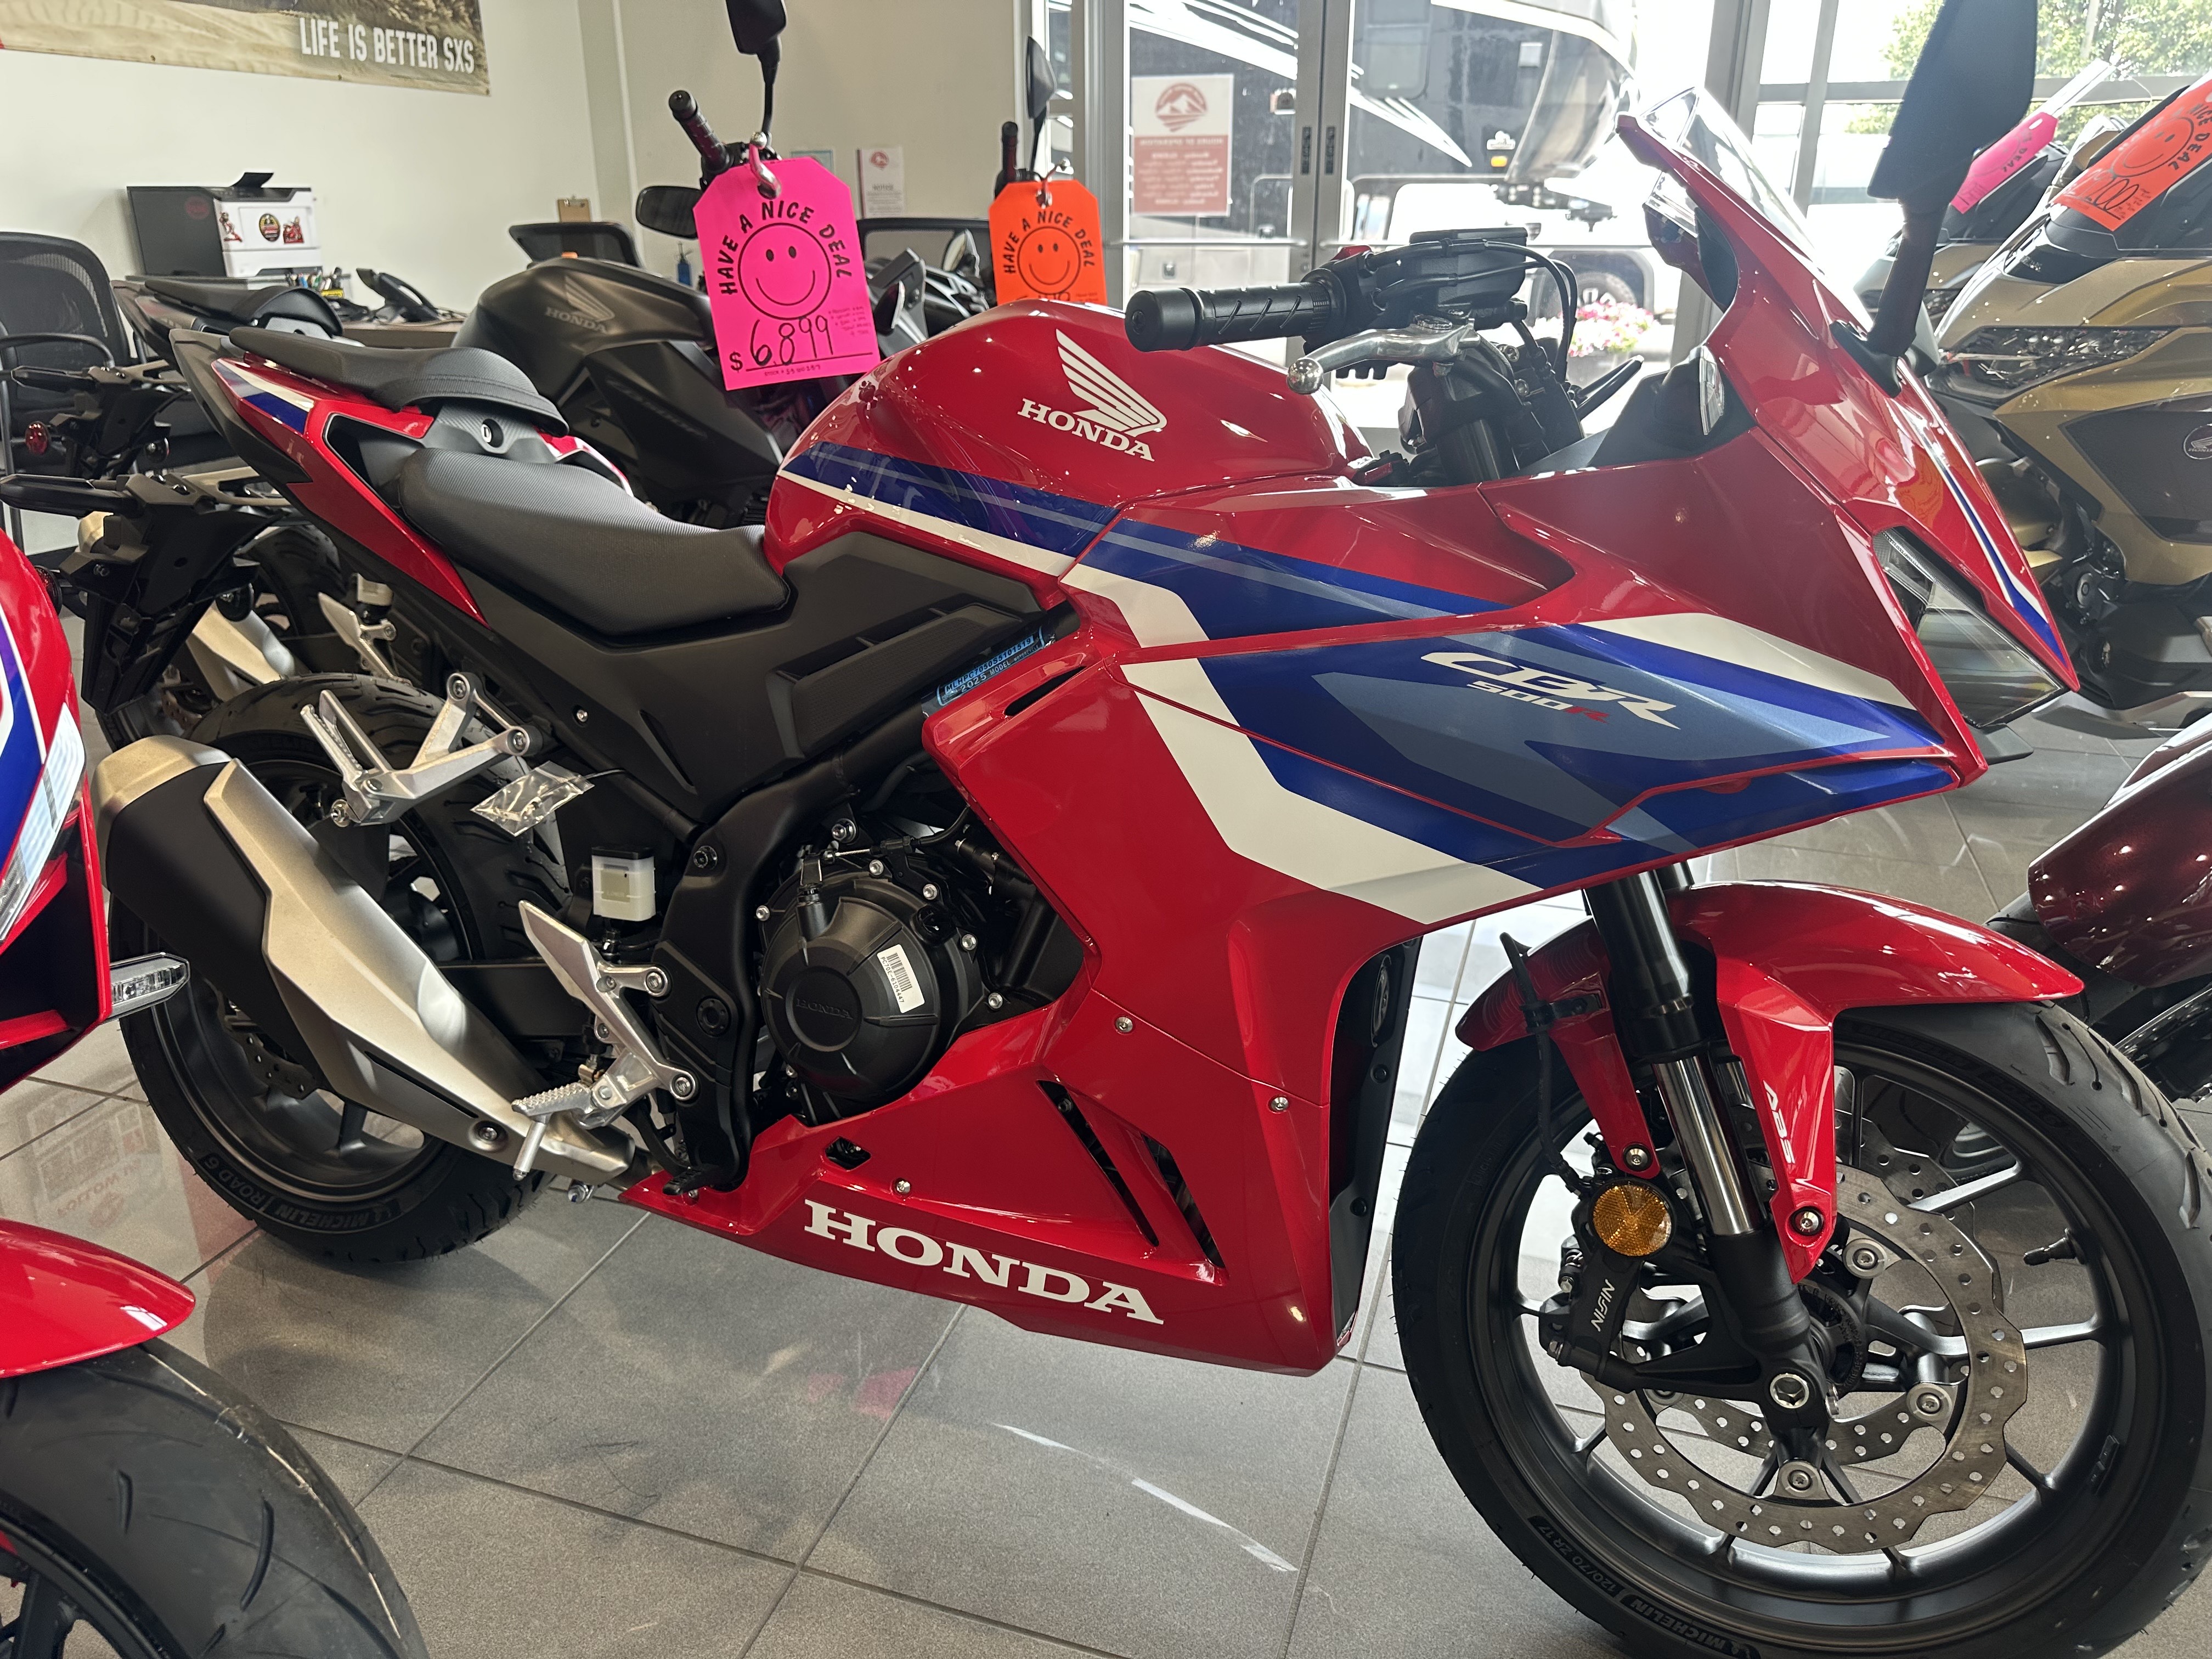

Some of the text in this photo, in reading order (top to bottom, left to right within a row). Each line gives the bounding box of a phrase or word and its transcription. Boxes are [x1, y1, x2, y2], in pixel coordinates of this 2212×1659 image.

[300, 17, 475, 74] LIFE IS BETTER SXS
[2168, 132, 2211, 170] DEAL
[717, 200, 853, 295] HAVE A NICE DEAL
[1003, 211, 1095, 274] HAVE A NICE DEAL
[545, 307, 610, 334] HONDA
[1017, 398, 1155, 462] HONDA
[961, 672, 987, 693] 2025
[989, 661, 1012, 676] MODEL
[1420, 652, 1681, 730] CBR
[796, 997, 854, 1020] HONDA
[204, 1155, 266, 1205] ROAD 6
[274, 1204, 370, 1228] MICHELIN
[804, 1199, 1164, 1325] HONDA
[1590, 1279, 1616, 1333] NISSIN
[1538, 1525, 1617, 1592] 120/70 ZR 17
[1630, 1598, 1727, 1651] MICHELIN
